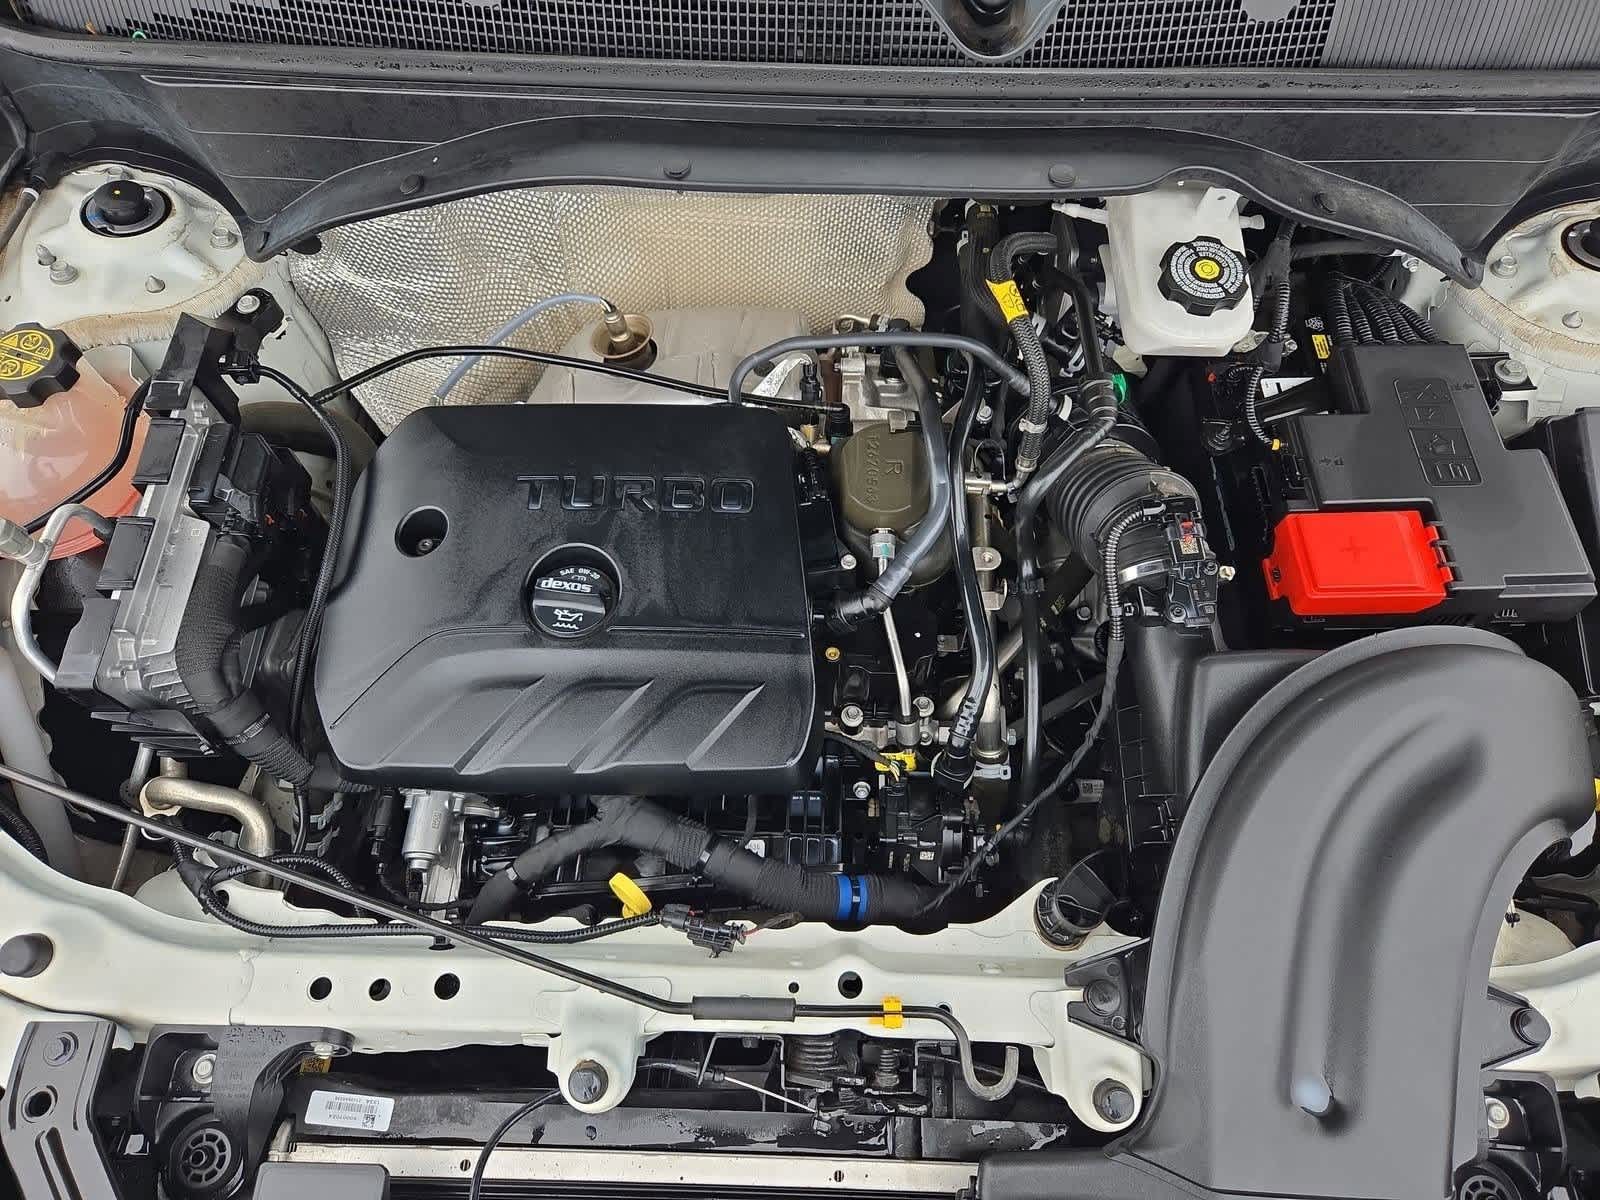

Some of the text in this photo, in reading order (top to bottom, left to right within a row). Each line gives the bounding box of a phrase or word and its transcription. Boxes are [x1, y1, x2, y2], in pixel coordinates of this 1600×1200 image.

[516, 475, 754, 513] TURBO
[559, 567, 575, 576] SAE
[540, 577, 593, 593] dexos
